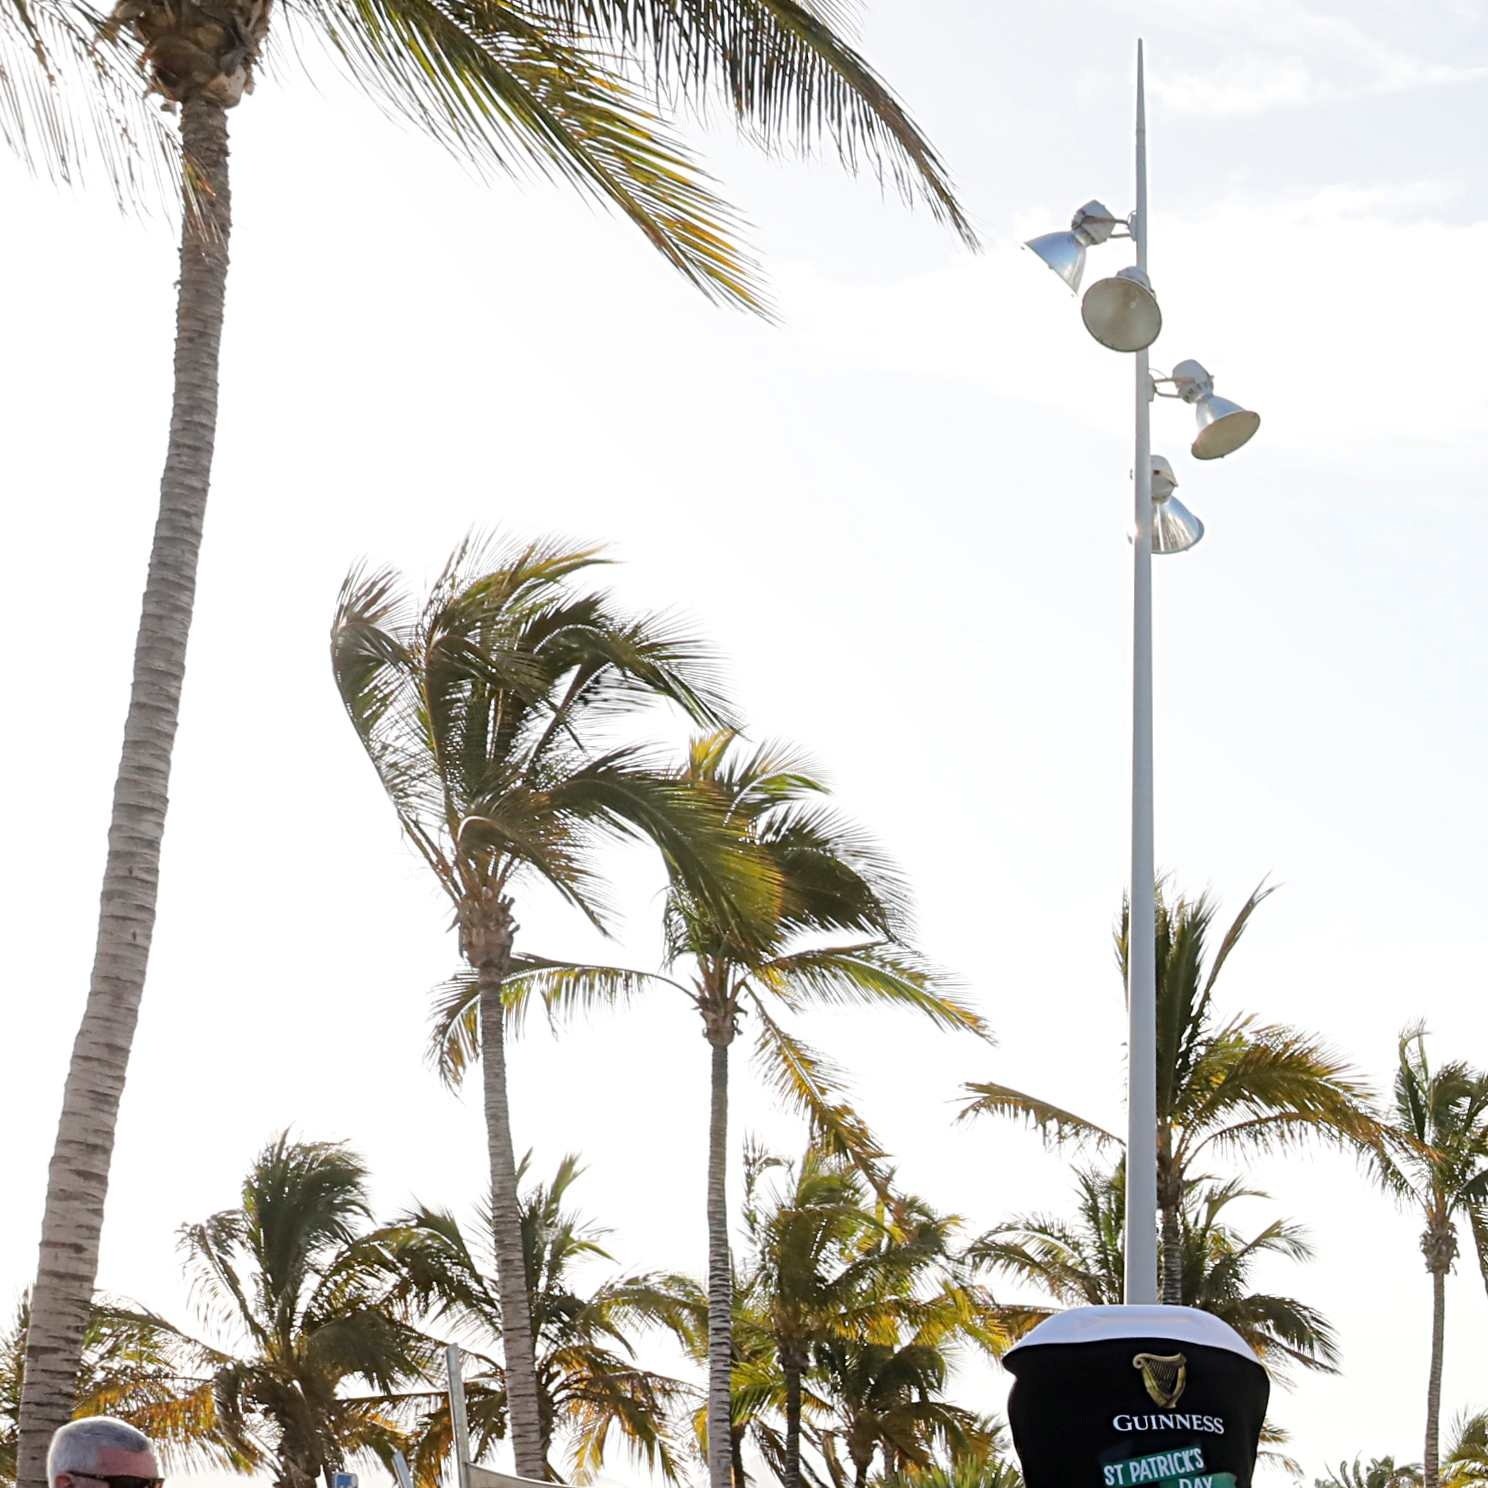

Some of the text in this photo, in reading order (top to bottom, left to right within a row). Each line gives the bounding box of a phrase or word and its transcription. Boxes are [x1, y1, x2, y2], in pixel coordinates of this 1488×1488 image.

[1112, 1413, 1225, 1435] GUINNESS
[1103, 1447, 1205, 1486] ST PATRICK'S
